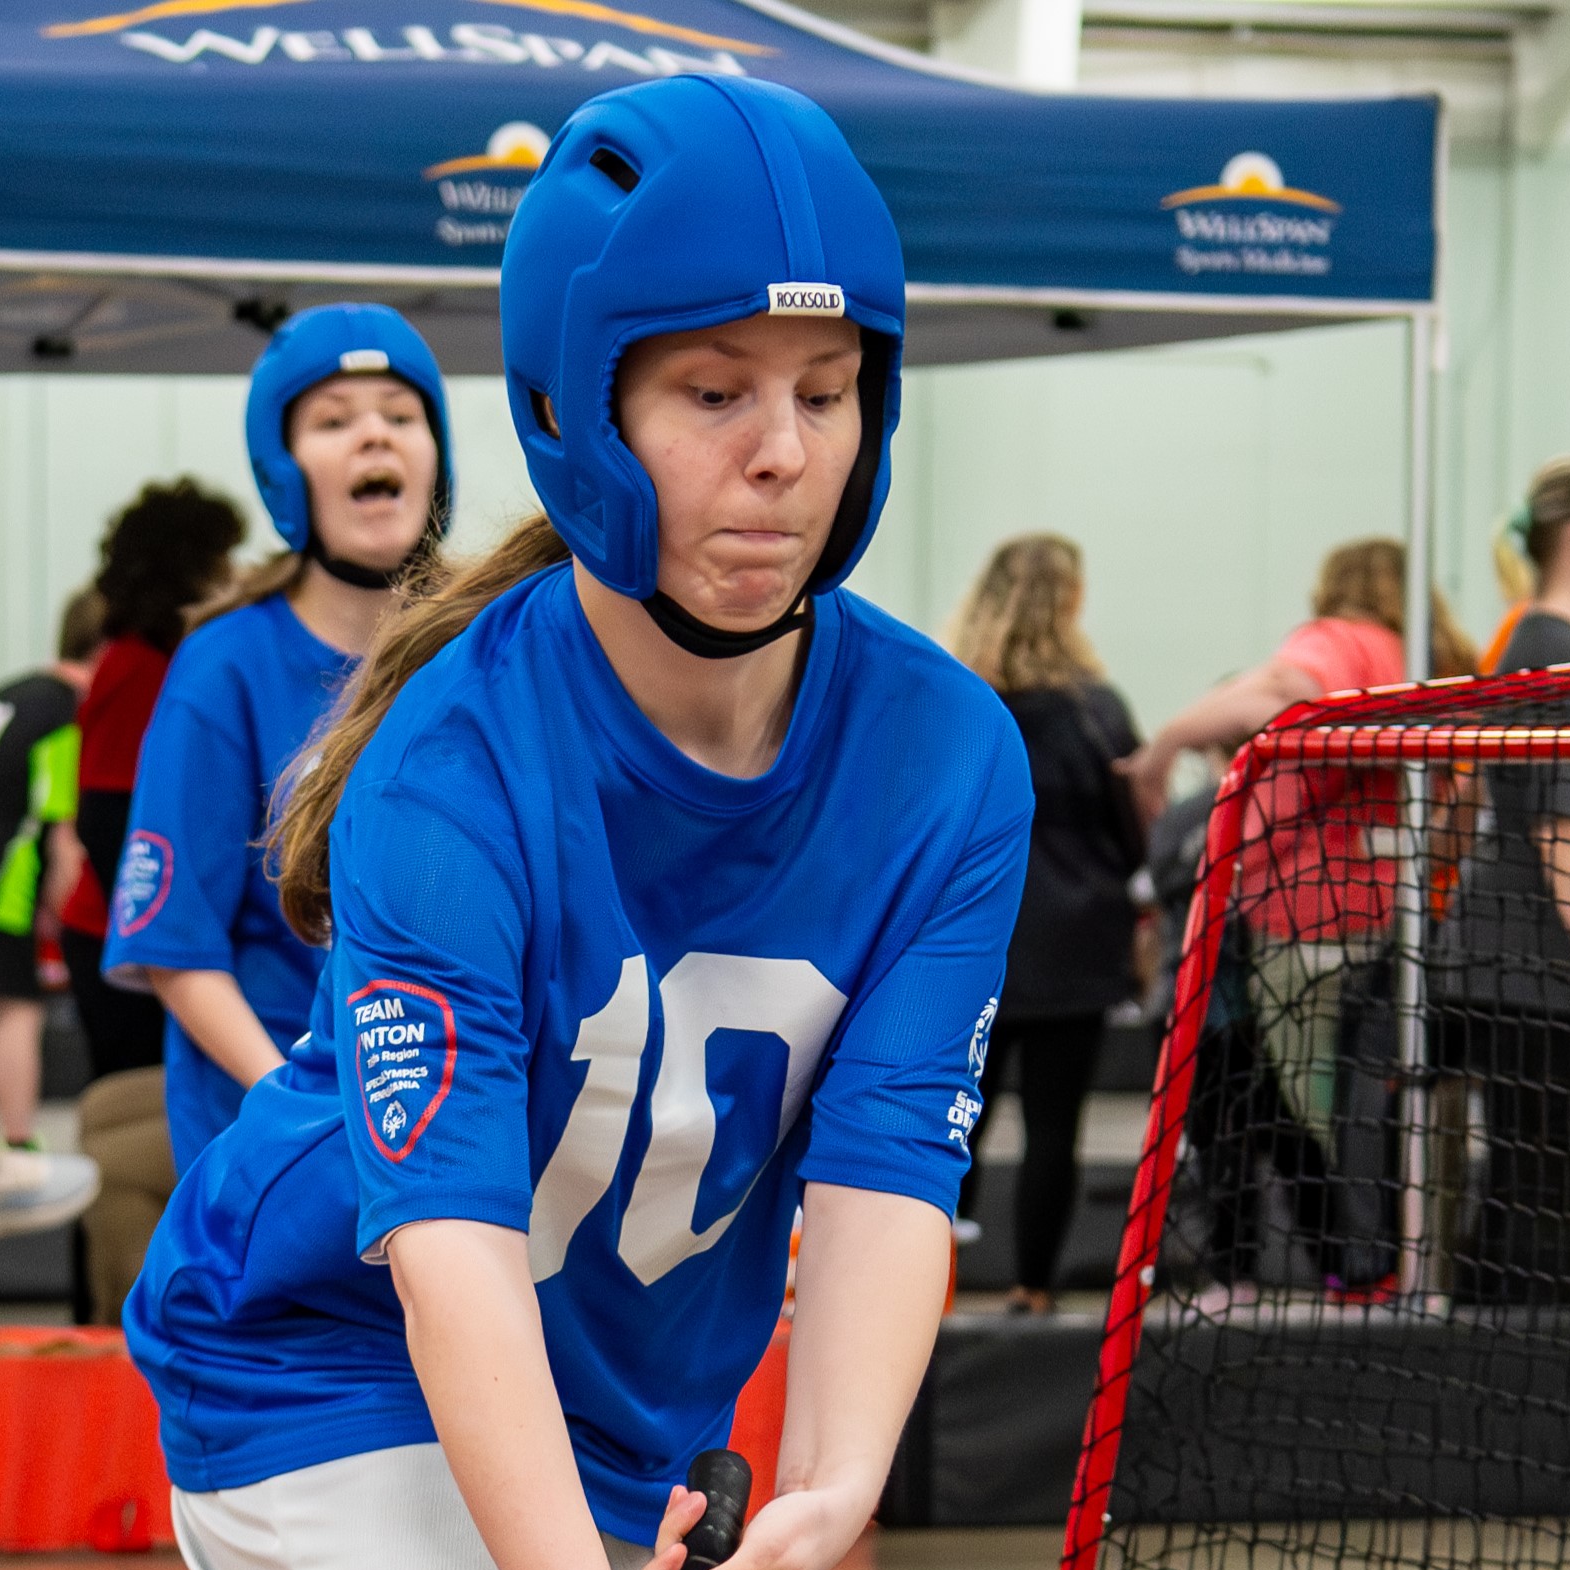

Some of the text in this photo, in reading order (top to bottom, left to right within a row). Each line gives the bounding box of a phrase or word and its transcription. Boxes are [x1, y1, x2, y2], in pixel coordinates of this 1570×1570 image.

[777, 291, 840, 308] ROCKSOLID
[354, 998, 405, 1026] TEAM
[360, 1022, 425, 1053] NTON
[381, 1048, 420, 1063] Region
[527, 951, 850, 1287] 10
